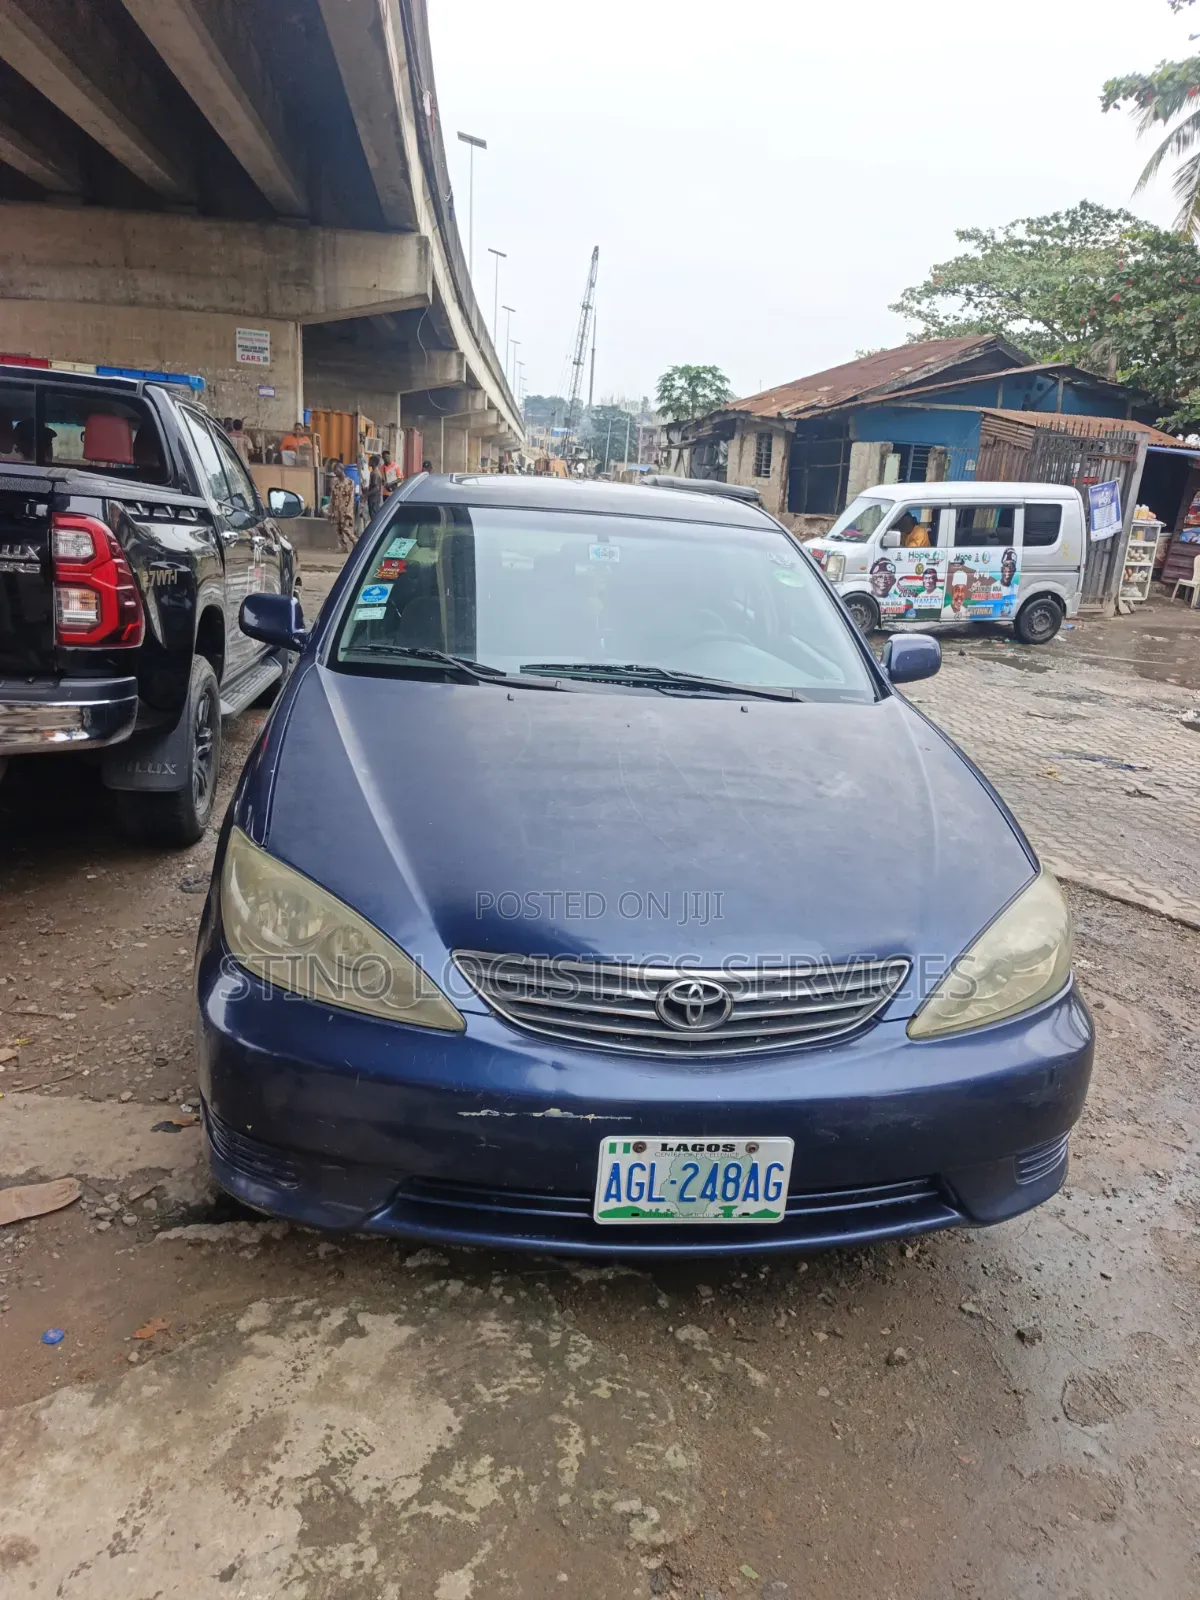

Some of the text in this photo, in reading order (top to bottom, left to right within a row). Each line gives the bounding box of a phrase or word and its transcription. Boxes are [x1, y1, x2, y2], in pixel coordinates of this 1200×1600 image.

[240, 354, 261, 362] CARS
[660, 1143, 736, 1153] LAGOS
[603, 1161, 785, 1203] AGL-248AG
